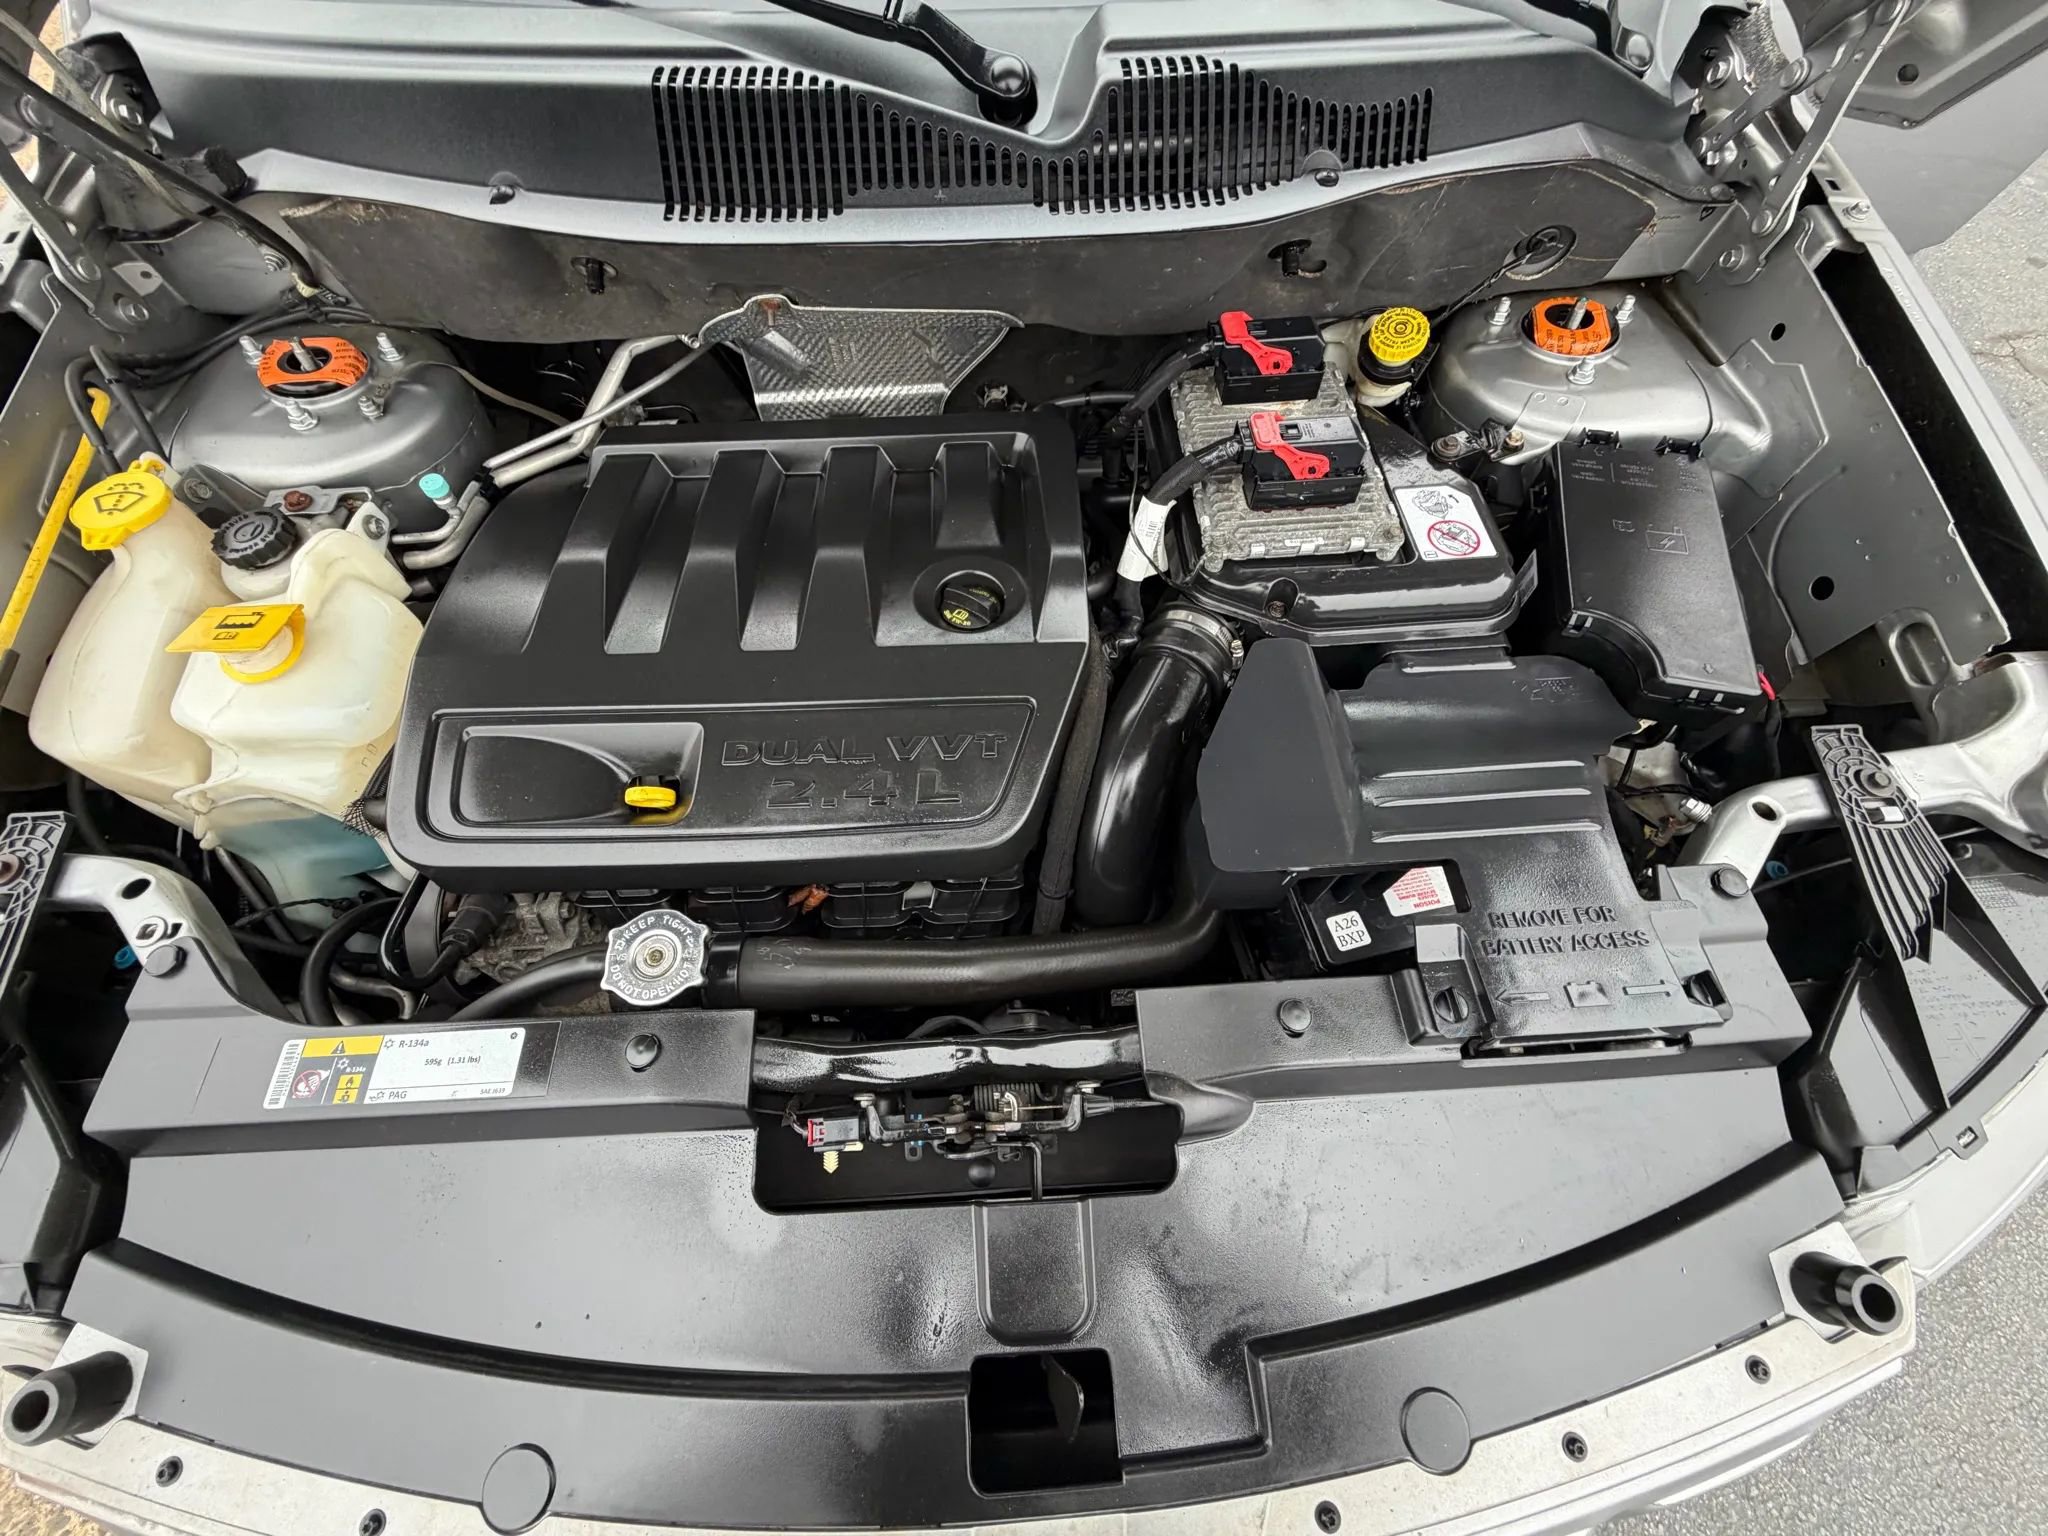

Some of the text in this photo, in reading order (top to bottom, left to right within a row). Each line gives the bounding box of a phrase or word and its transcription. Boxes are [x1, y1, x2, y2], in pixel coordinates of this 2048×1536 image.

[721, 733, 1008, 766] DUAL VVT
[1412, 899, 1441, 909] POISON
[1334, 915, 1359, 932] A26
[1488, 905, 1617, 928] REMOVE FOR
[622, 914, 692, 939] KEEP TIGHT
[1336, 929, 1366, 948] BXP
[1481, 929, 1650, 957] BATTERY ACCESS
[610, 964, 623, 980] DO
[617, 981, 641, 998] NOT
[398, 1038, 430, 1049] R-134a
[424, 1057, 443, 1067] 595g
[447, 1056, 466, 1067] (1.31
[388, 1090, 408, 1100] PAG
